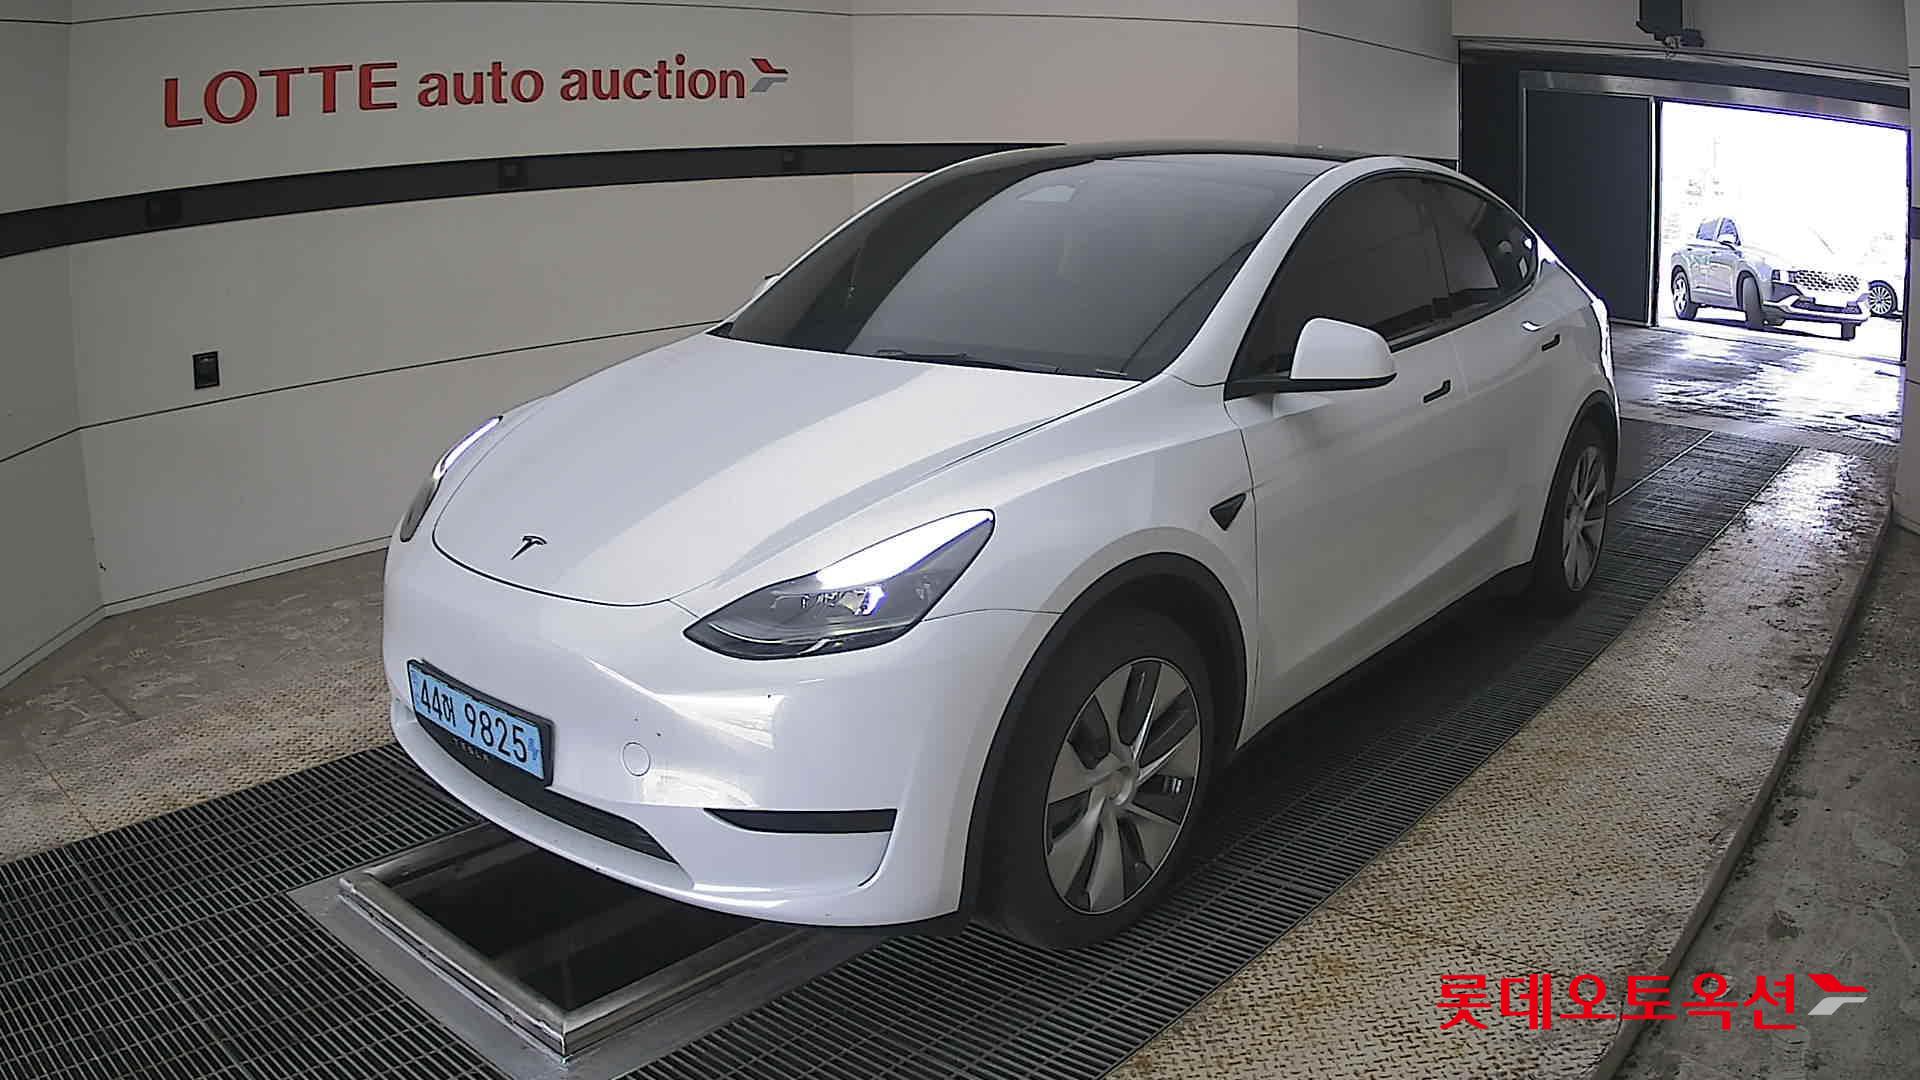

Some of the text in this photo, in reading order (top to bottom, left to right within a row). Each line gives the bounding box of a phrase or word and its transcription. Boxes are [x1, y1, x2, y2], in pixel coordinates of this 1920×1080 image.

[164, 54, 746, 128] LOTTE auto auction
[420, 679, 457, 728] 44허
[464, 703, 528, 763] 9825
